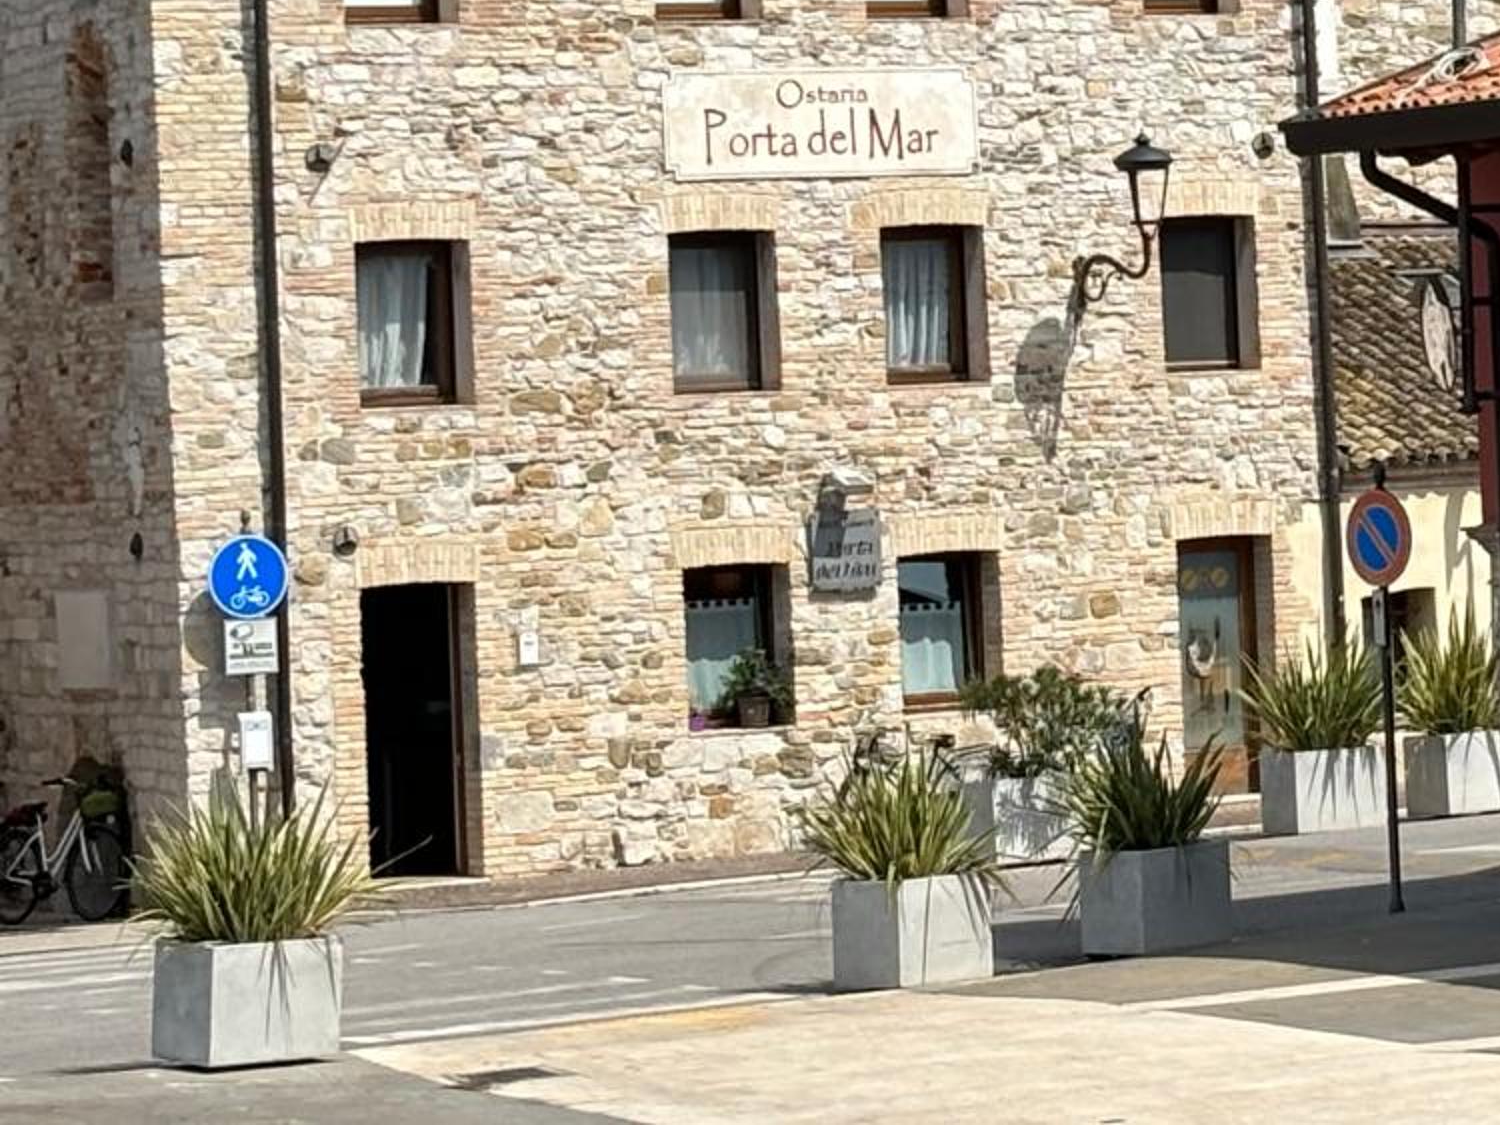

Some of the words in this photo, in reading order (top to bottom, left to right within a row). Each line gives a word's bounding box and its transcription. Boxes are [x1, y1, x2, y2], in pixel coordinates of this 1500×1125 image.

[704, 108, 798, 165] Porta
[807, 106, 857, 156] del
[869, 107, 939, 160] Mar
